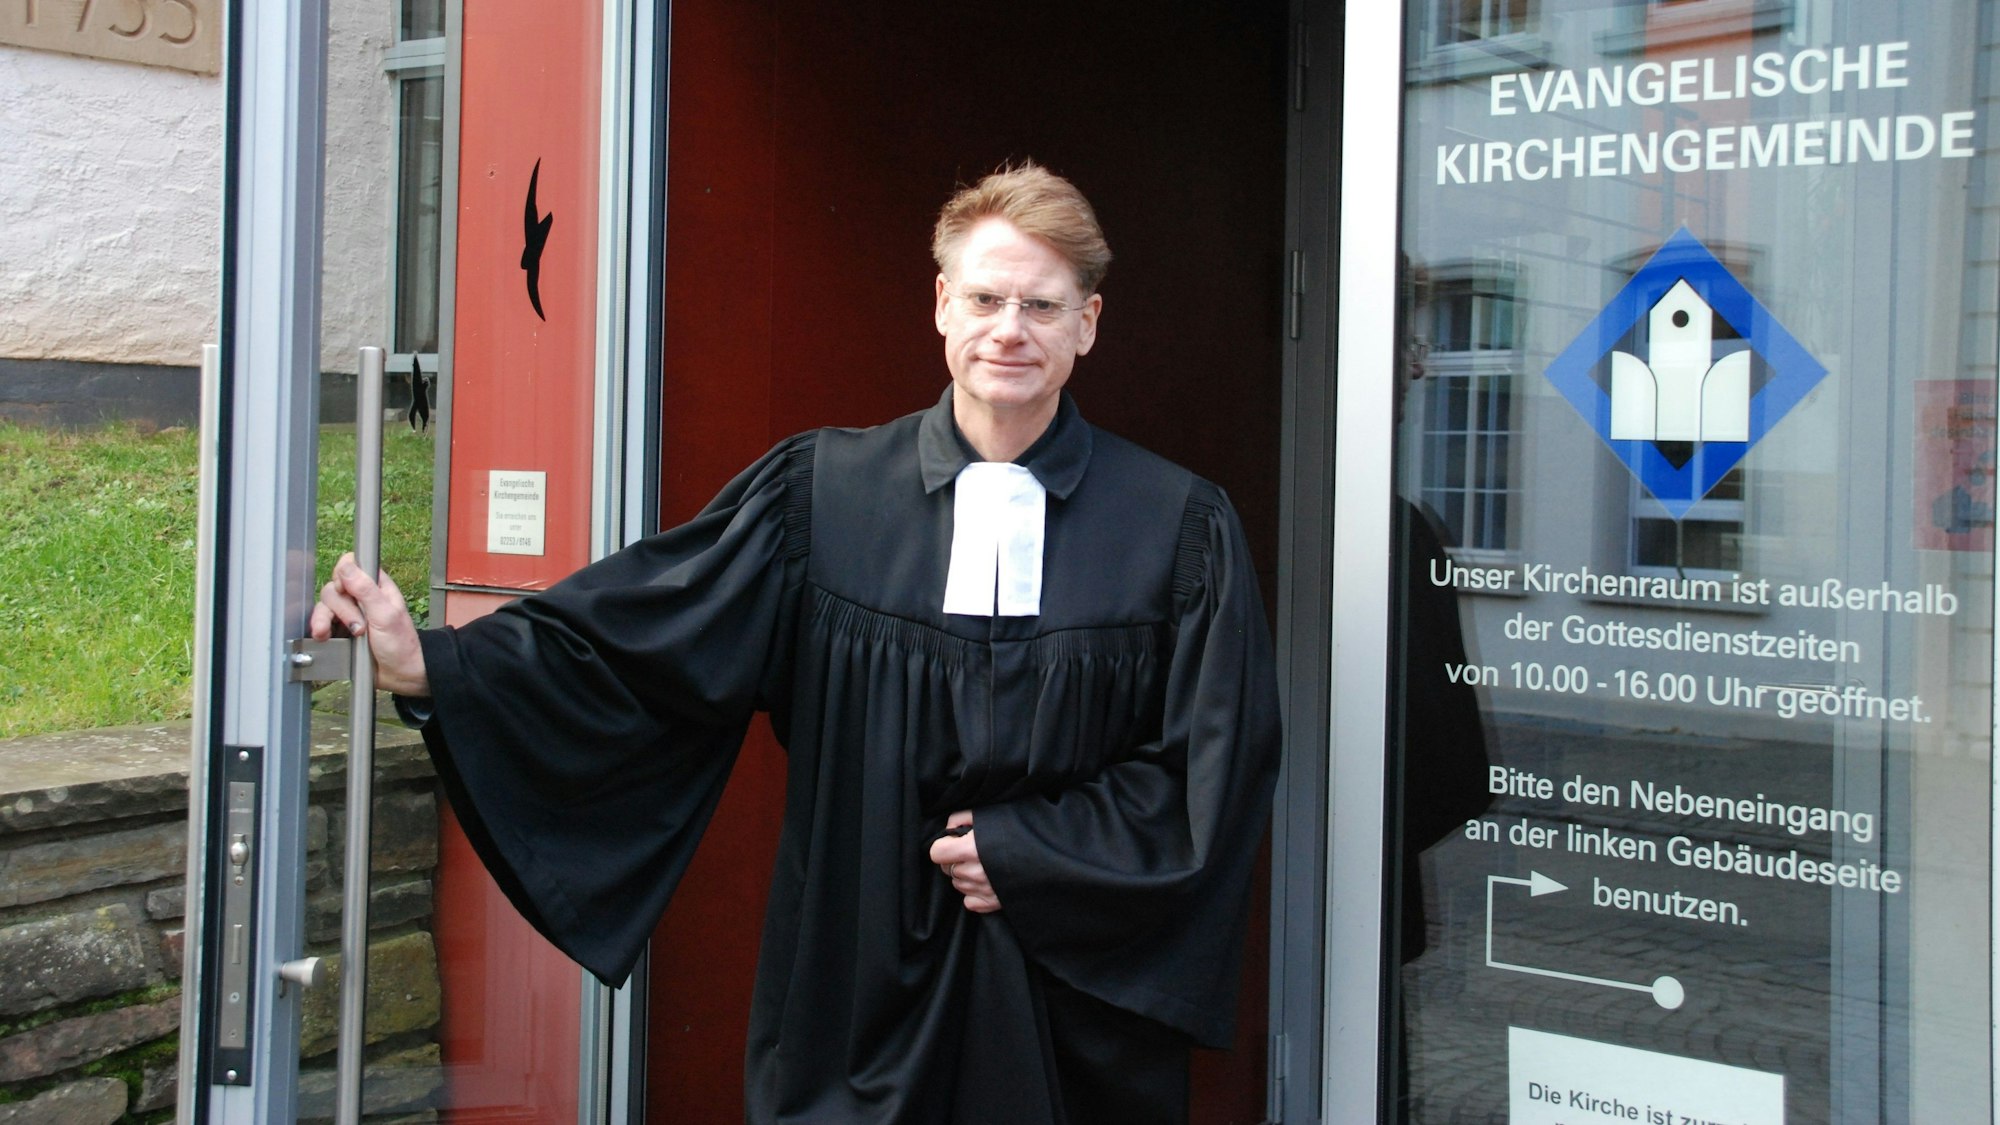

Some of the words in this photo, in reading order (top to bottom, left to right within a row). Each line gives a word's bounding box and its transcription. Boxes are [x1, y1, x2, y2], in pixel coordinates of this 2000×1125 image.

[1490, 41, 1909, 116] EVANGELISCHE
[1437, 111, 1975, 185] KIRCHENGEMEINDE
[494, 491, 539, 501] Kirchengemeinde
[500, 478, 535, 489] Evangelische
[1429, 558, 1515, 590] Unser
[1523, 563, 1722, 602] Kirchenraum
[1732, 573, 1769, 605] ist
[1778, 577, 1958, 616] außerhalb
[1504, 612, 1553, 641] der
[1561, 614, 1860, 663] Gottesdienstzeiten
[1445, 661, 1499, 687] von
[1510, 661, 1588, 694] 10.00
[1614, 671, 1696, 702] 16.00
[1707, 675, 1768, 709] Uhr
[1777, 684, 1932, 723] geöffnet.
[1488, 765, 1553, 800] Bitte
[1562, 774, 1620, 807] den
[1631, 780, 1874, 843] Nebeneingang
[1464, 817, 1500, 842] an
[1508, 817, 1558, 849] der
[1567, 823, 1656, 862] linken
[1667, 836, 1902, 894] Gebäudeseite
[1593, 877, 1749, 926] benutzen.
[1528, 1082, 1561, 1105] Die
[1569, 1089, 1639, 1120] Kirche
[1646, 1105, 1673, 1125] ist
